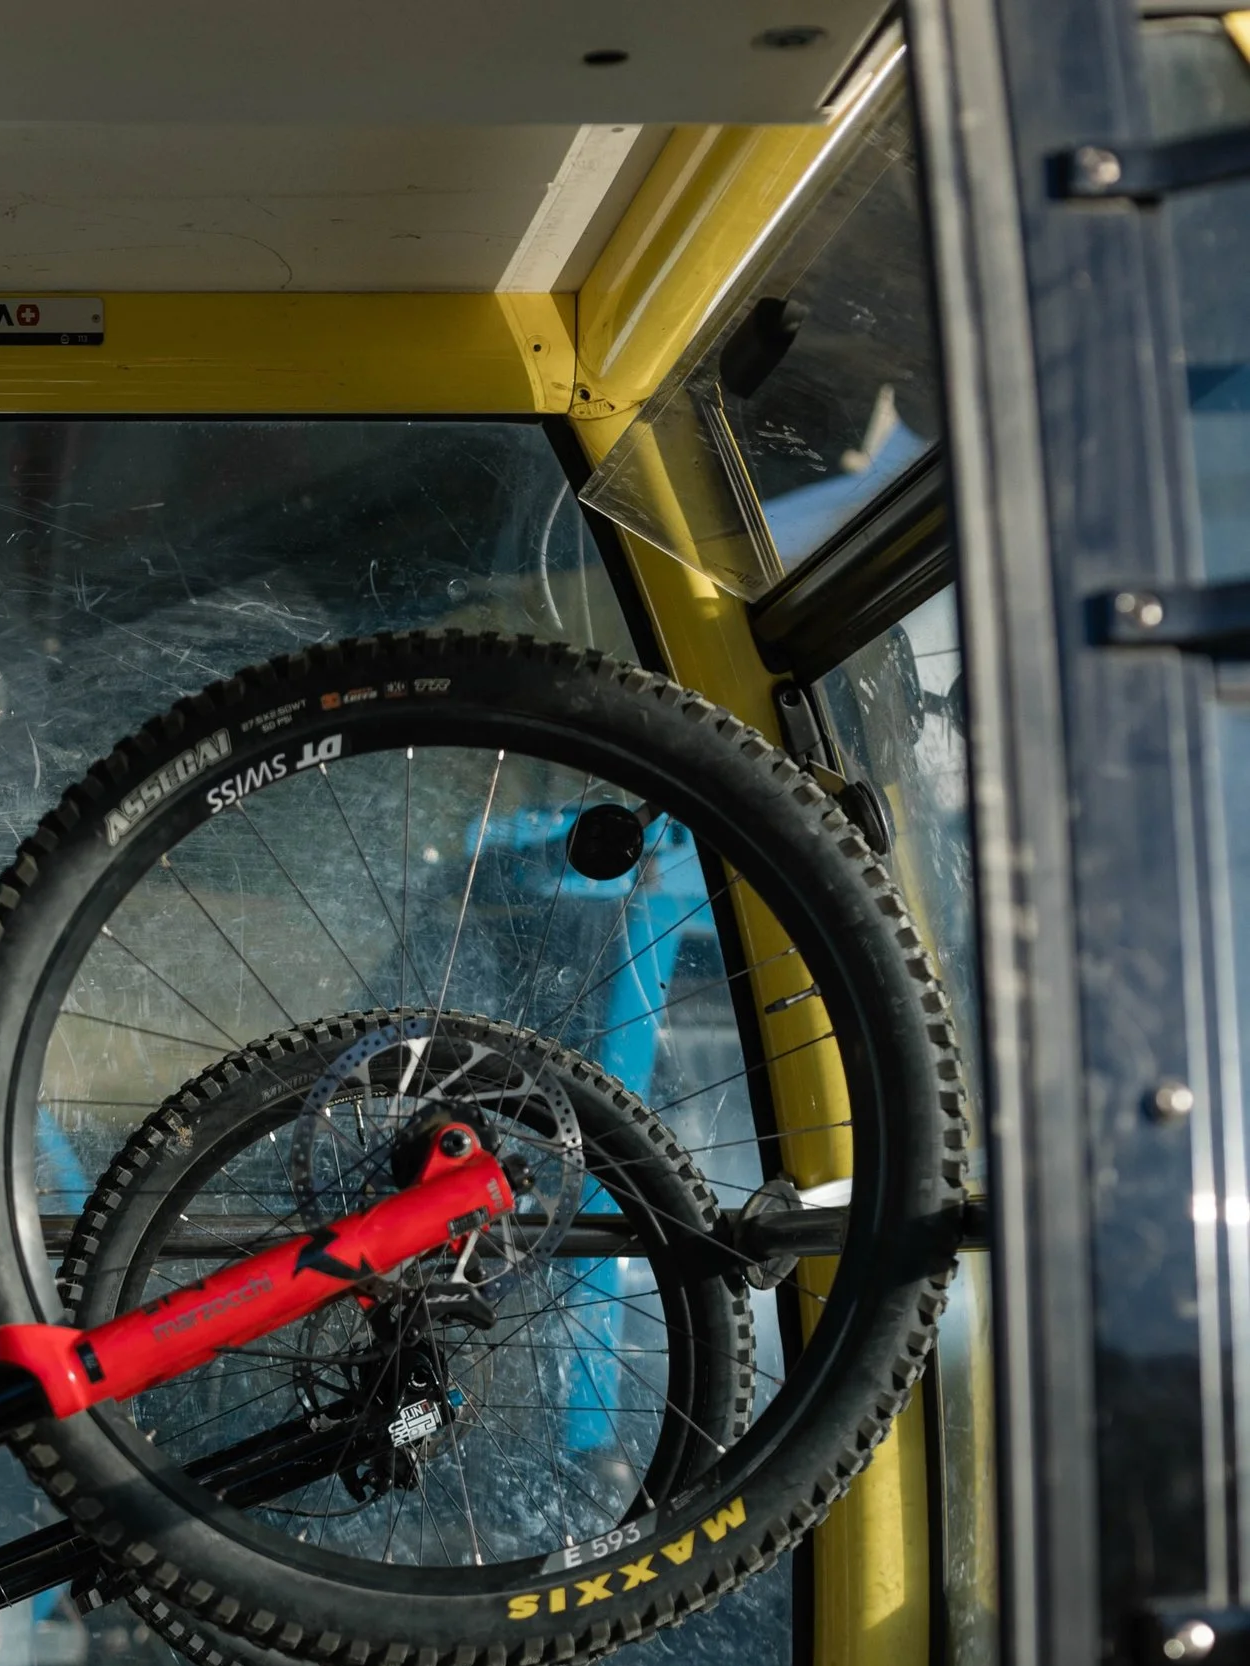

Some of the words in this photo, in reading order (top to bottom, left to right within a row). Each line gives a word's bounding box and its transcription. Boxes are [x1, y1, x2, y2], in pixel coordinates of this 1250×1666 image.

[205, 752, 287, 815] SWISS
[296, 733, 343, 772] DT
[104, 727, 232, 847] ASSEGAI
[151, 1270, 273, 1343] marzocchi
[507, 1496, 747, 1620] MAXXIS
[591, 1522, 642, 1558] 593
